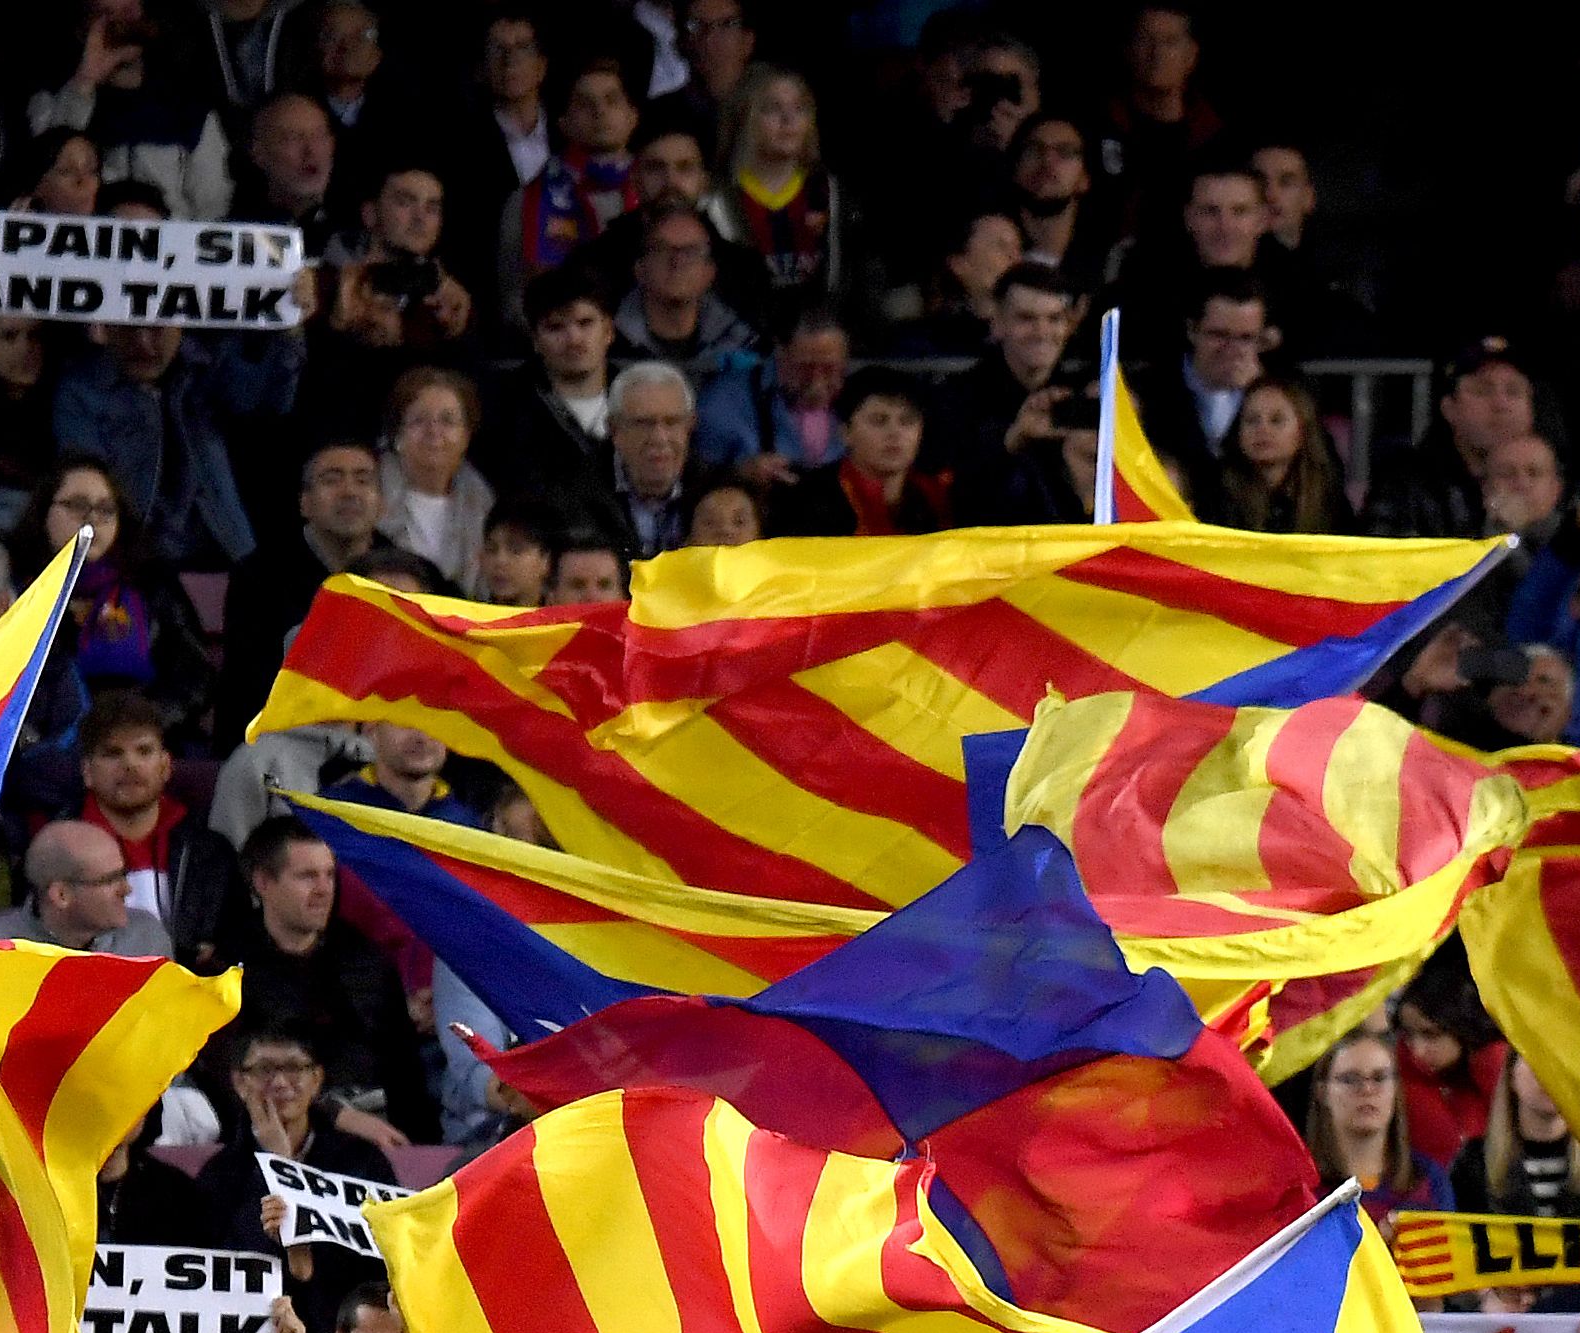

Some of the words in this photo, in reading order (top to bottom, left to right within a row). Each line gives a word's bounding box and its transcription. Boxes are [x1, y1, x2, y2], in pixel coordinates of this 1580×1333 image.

[194, 230, 292, 268] SIT
[121, 282, 290, 323] TALK
[294, 1205, 373, 1251] AN
[164, 1253, 273, 1294] SIT
